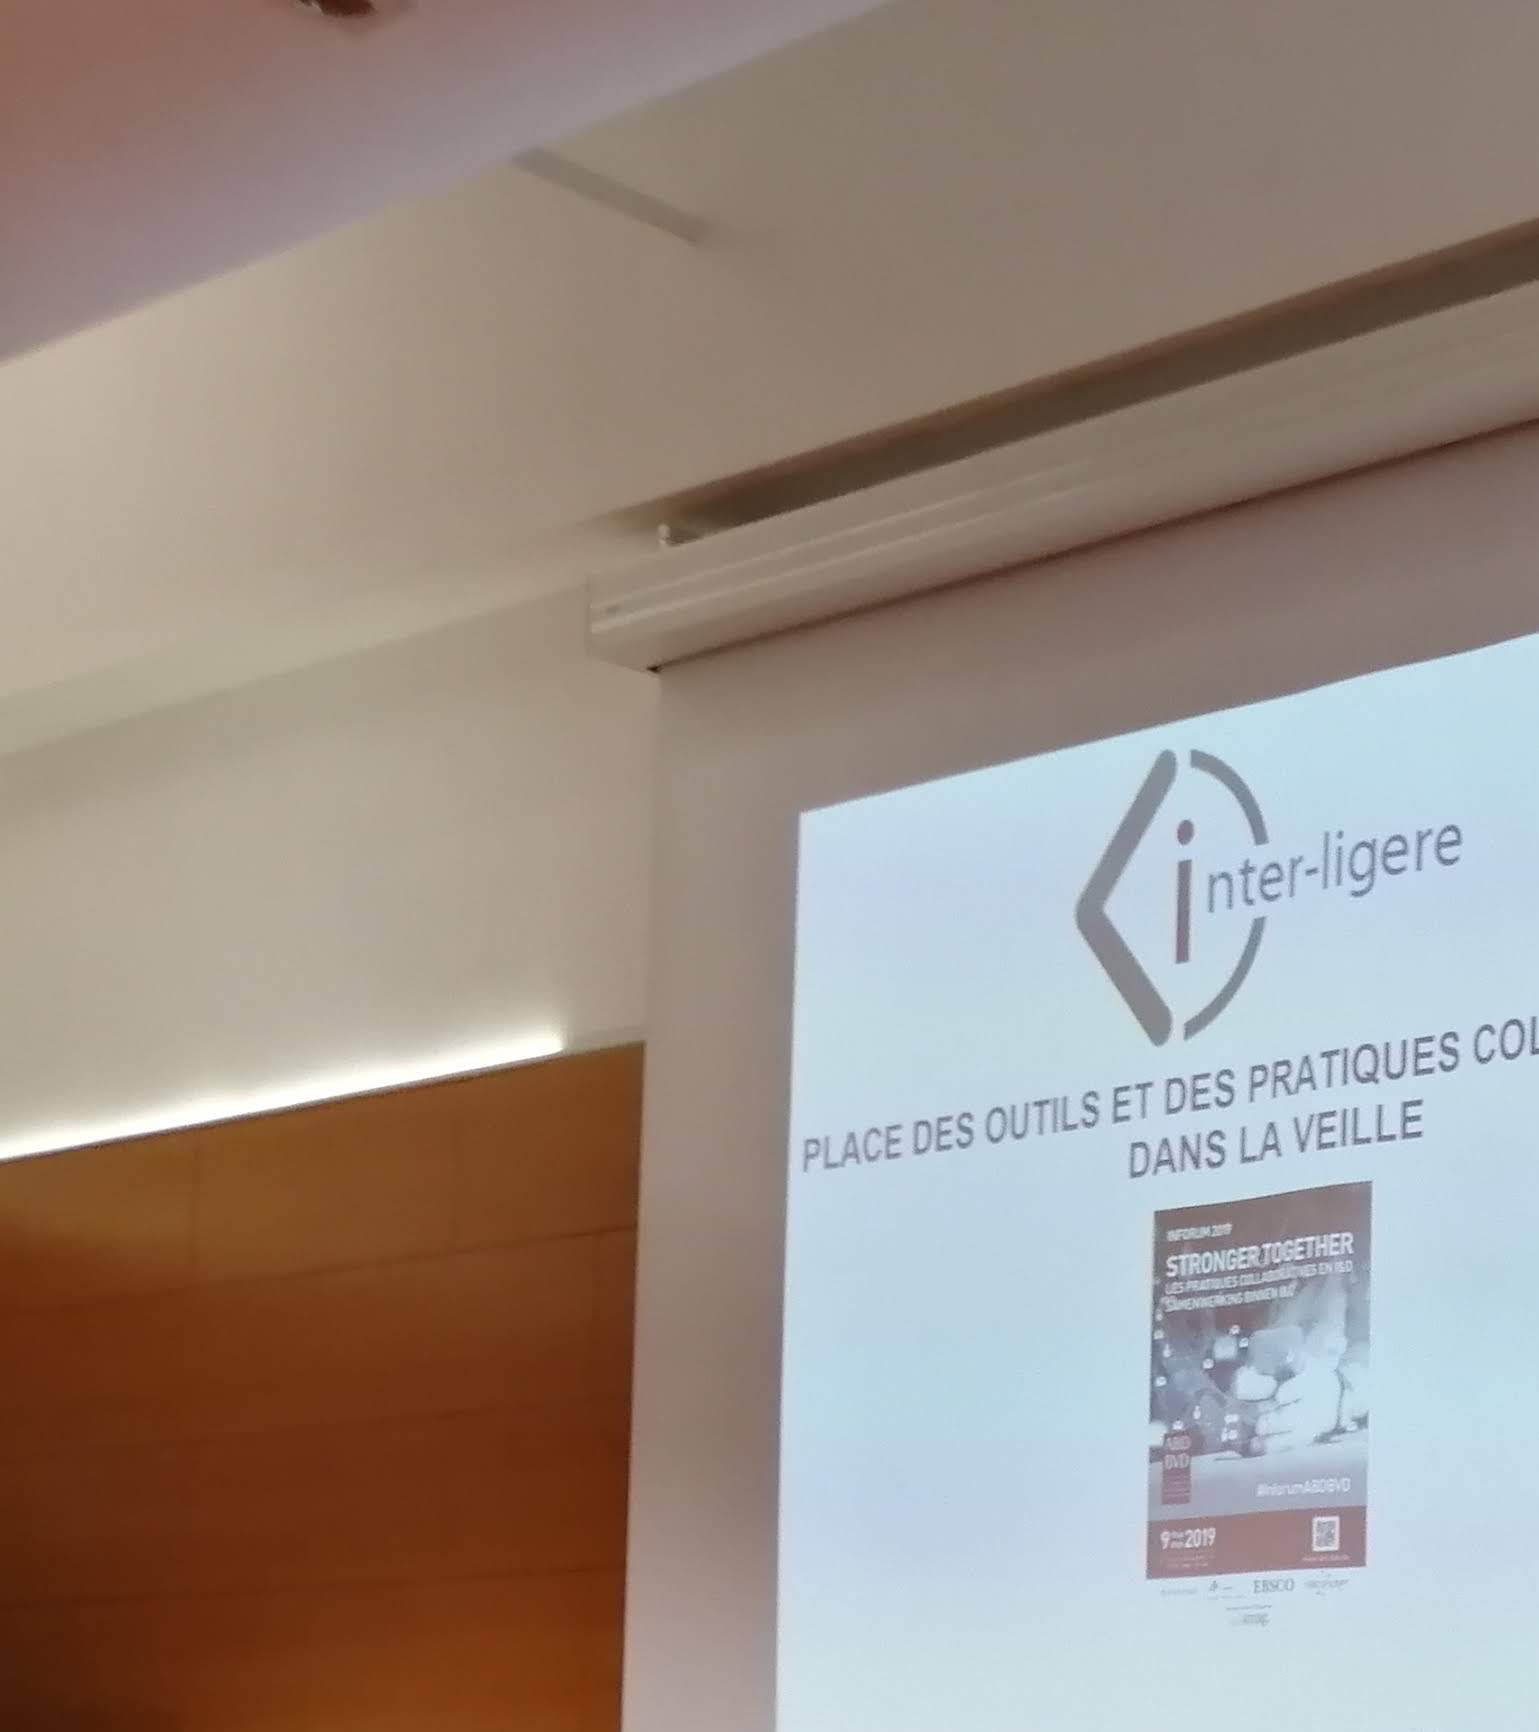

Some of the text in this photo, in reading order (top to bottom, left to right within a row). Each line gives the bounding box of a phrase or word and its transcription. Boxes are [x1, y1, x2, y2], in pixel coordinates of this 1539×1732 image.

[803, 1123, 903, 1173] PLACE
[912, 1111, 975, 1155] DES
[985, 1089, 1101, 1144] OUTILS
[1112, 1080, 1154, 1124] ET
[1164, 1068, 1236, 1116] DES
[1249, 1030, 1460, 1103] PRATIQUES
[1129, 1099, 1425, 1179] DANS LA VEILLE
[1261, 1231, 1355, 1269] TOGETHER
[1160, 1530, 1170, 1550] 9
[1185, 1527, 1217, 1549] 2019
[1253, 1577, 1295, 1594] EBSCO
